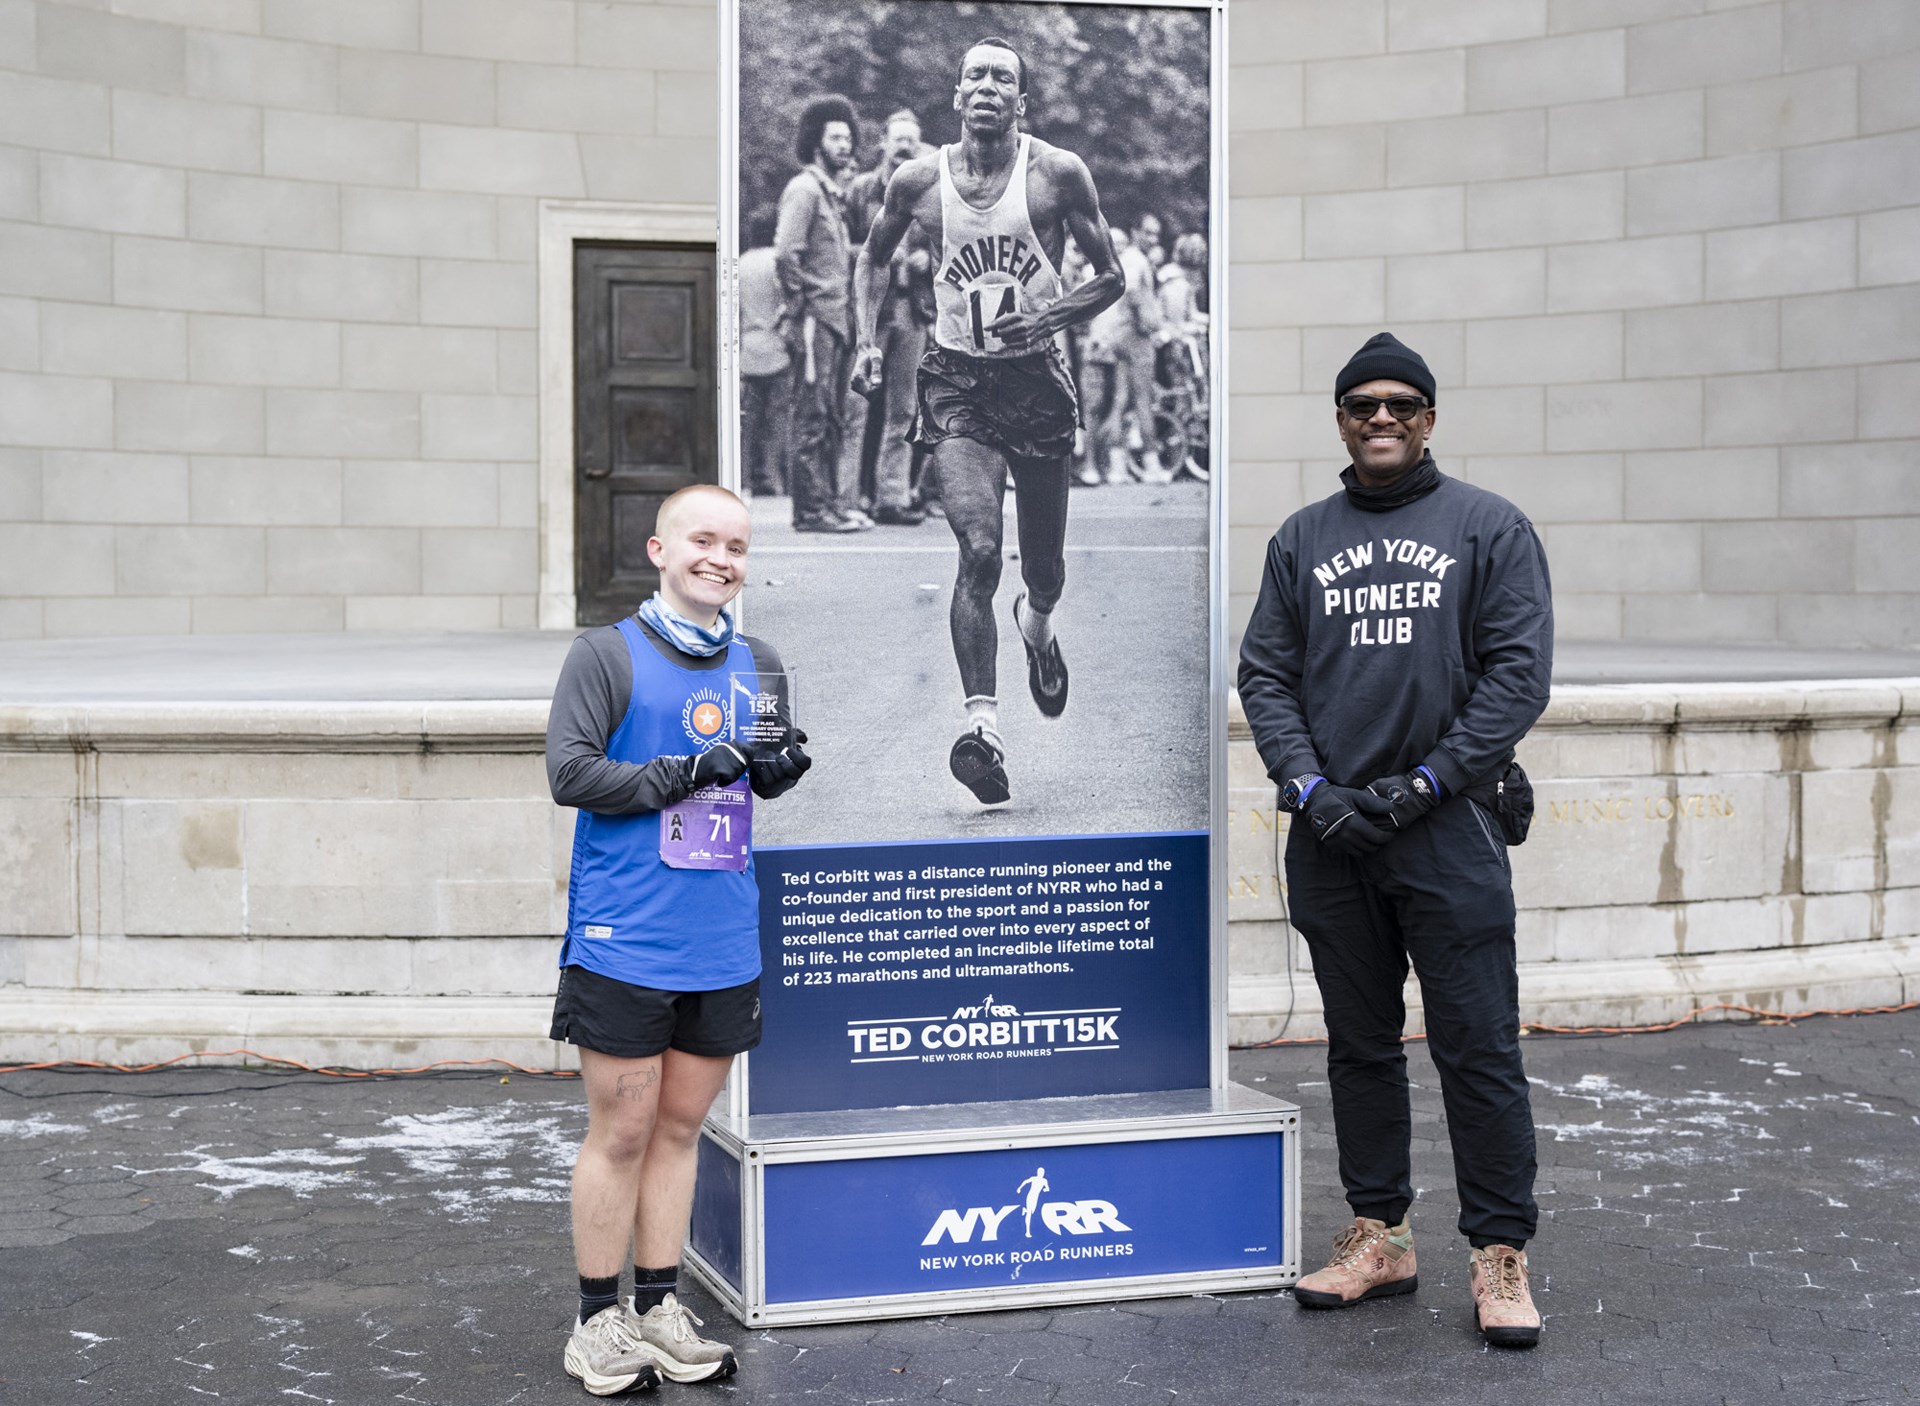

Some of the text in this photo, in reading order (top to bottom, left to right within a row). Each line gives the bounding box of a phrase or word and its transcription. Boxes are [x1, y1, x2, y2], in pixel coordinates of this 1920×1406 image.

[943, 234, 1042, 292] PIONEER
[1312, 538, 1457, 588] NEW YORK
[1324, 581, 1442, 616] PIONEER
[1350, 616, 1413, 647] CLUB
[748, 700, 779, 714] 15K
[1250, 807, 1291, 833] NE
[1549, 799, 1632, 825] MUSIC
[1644, 793, 1736, 822] LOVERS
[709, 813, 731, 843] 71
[781, 858, 1172, 886] Ted Corbitt was a distance running pioneer and the
[781, 878, 1163, 906] co-founder and first president of NYRR who had a
[782, 898, 1150, 927] unique dedication to the sport and a passion for
[782, 916, 1151, 946] excellence that carried over into every aspect of
[782, 936, 1154, 967] his life. He completed an incredible lifetime total
[782, 960, 1074, 987] of 223 marathons and ultramarathons.
[847, 1026, 912, 1054] TED
[921, 1048, 1052, 1063] NEW YORK ROAD RUNNERS
[920, 1199, 1134, 1246] NYRR
[920, 1243, 1134, 1271] NEW YORK ROAD RUNNERS
